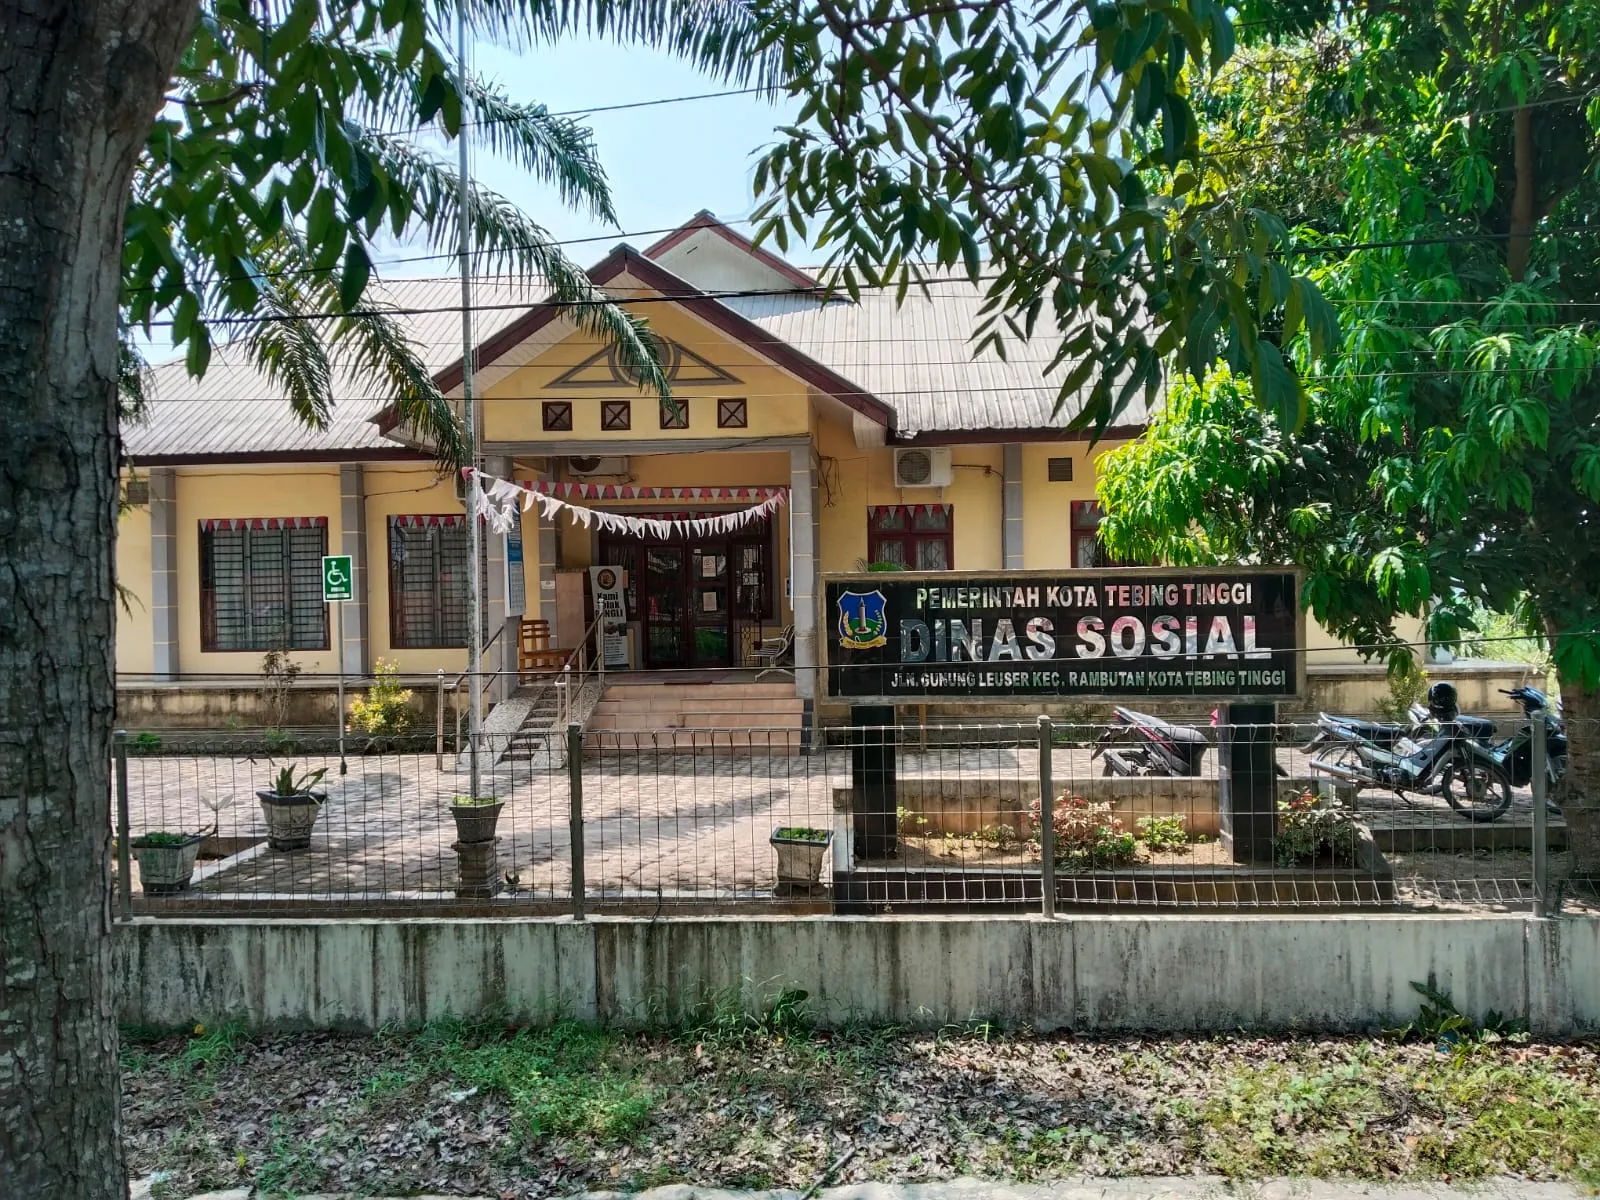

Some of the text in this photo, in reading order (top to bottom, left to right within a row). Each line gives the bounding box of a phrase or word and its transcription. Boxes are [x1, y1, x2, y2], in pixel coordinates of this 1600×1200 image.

[916, 583, 1252, 609] PEMERINTAH KOTA TEBING TINGGI
[595, 608, 623, 618] PNGLI
[900, 615, 1272, 662] DINAS SOSIAL
[920, 672, 976, 687] GUNUNG
[978, 671, 1030, 687] LEUSER
[1032, 671, 1065, 687] KEC.
[1069, 670, 1145, 687] RAMBUTAN
[1148, 671, 1184, 687] KOTA
[1186, 670, 1236, 686] TEBING
[1239, 670, 1286, 686] TINGGI
